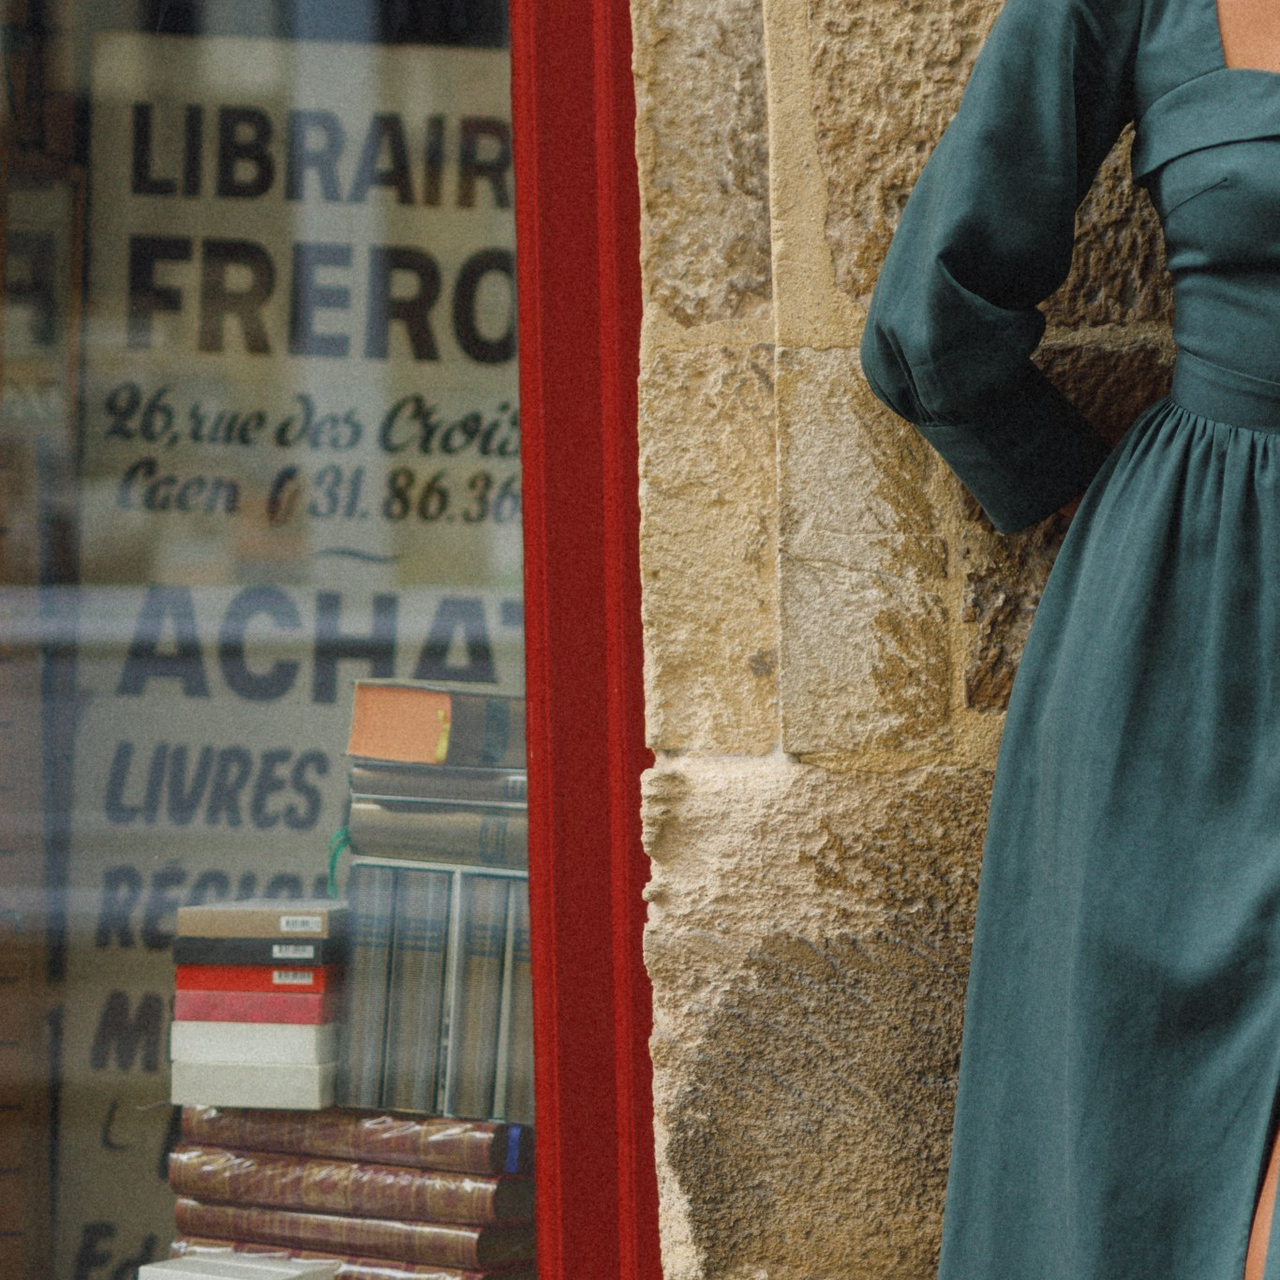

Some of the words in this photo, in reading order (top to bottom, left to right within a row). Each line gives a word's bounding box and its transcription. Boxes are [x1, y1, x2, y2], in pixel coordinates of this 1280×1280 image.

[129, 102, 513, 209] LIBRAIR
[126, 234, 518, 364] FRERO
[275, 392, 363, 451] des
[115, 585, 524, 704] ACHA
[103, 740, 329, 831] LIVRES
